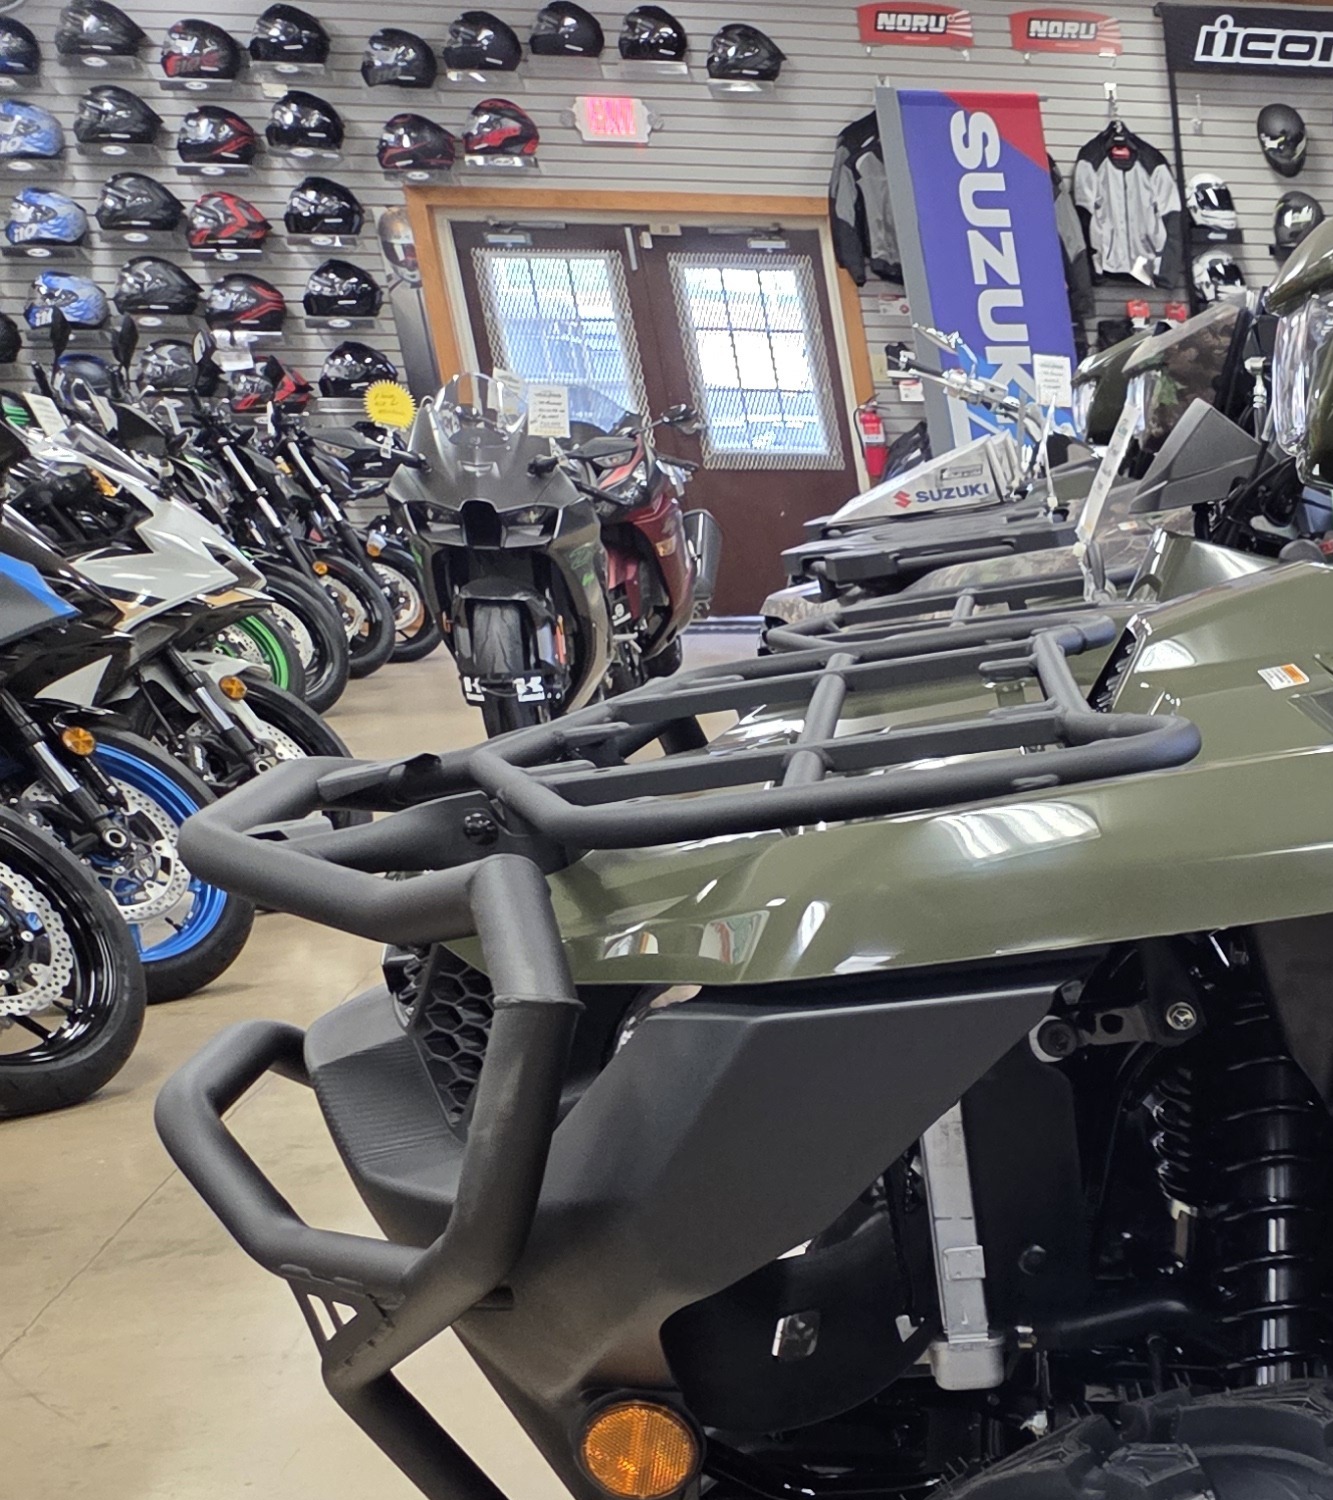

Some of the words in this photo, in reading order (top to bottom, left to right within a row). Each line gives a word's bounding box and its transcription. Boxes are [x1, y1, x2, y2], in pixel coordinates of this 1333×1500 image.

[876, 13, 947, 33] NORU
[1028, 20, 1096, 39] NORU
[950, 109, 1042, 405] SUZUK
[915, 483, 990, 503] SUZUKI
